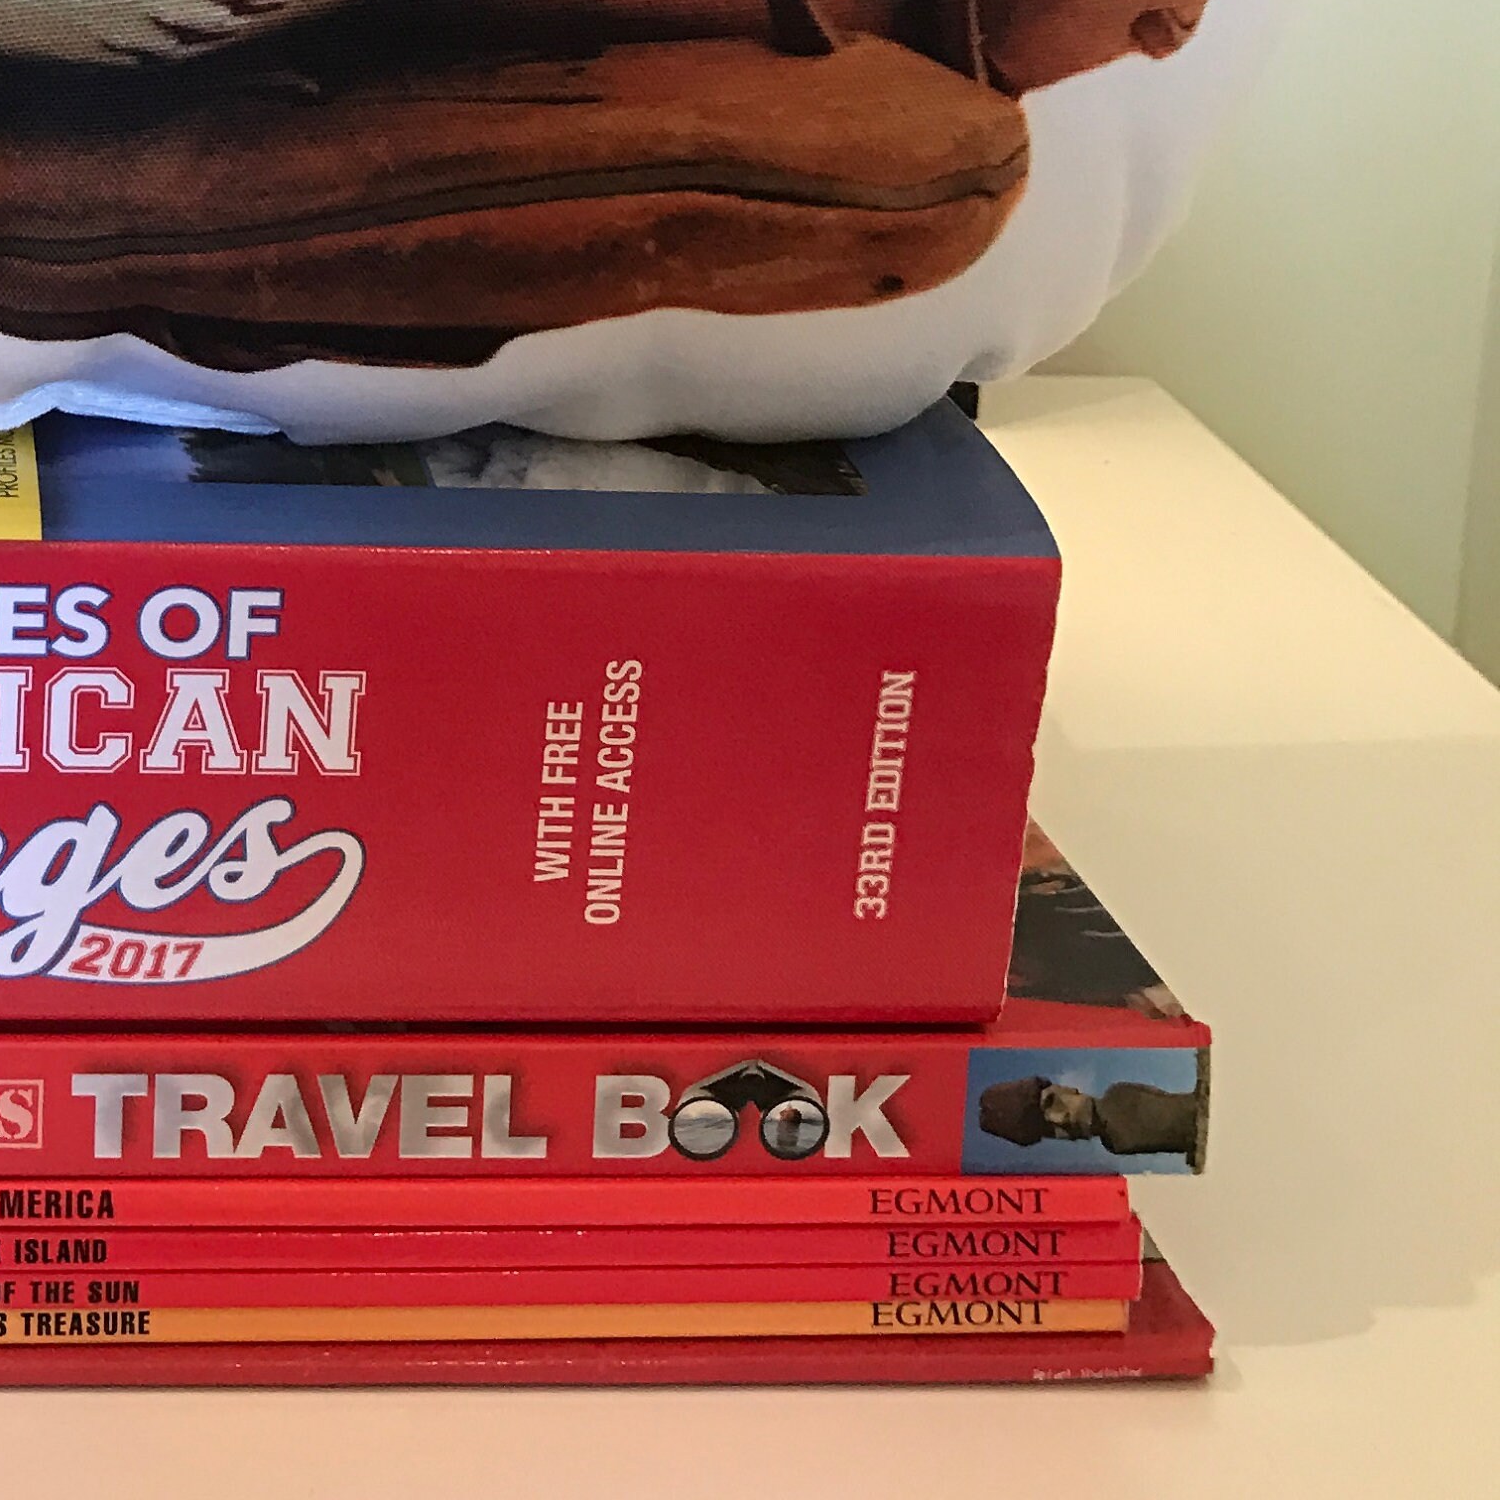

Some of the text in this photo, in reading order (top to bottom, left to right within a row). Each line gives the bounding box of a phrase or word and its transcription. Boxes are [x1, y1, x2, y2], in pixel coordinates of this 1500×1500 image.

[138, 585, 284, 660] OF
[534, 701, 583, 883] WITH FREE
[584, 659, 643, 926] ONLINE ACCESS
[855, 670, 916, 920] 33RD EDITION
[70, 935, 204, 980] 2017
[72, 1073, 547, 1159] TRAVEL
[868, 1188, 1049, 1214] EGMONT
[14, 1239, 108, 1265] ISLAND
[887, 1229, 1066, 1257] EGMONT
[29, 1280, 75, 1304] THE
[87, 1280, 140, 1304] SUN
[888, 1271, 1068, 1297] EGMONT
[20, 1310, 151, 1337] TREASURE
[871, 1300, 1049, 1327] EGMONT
